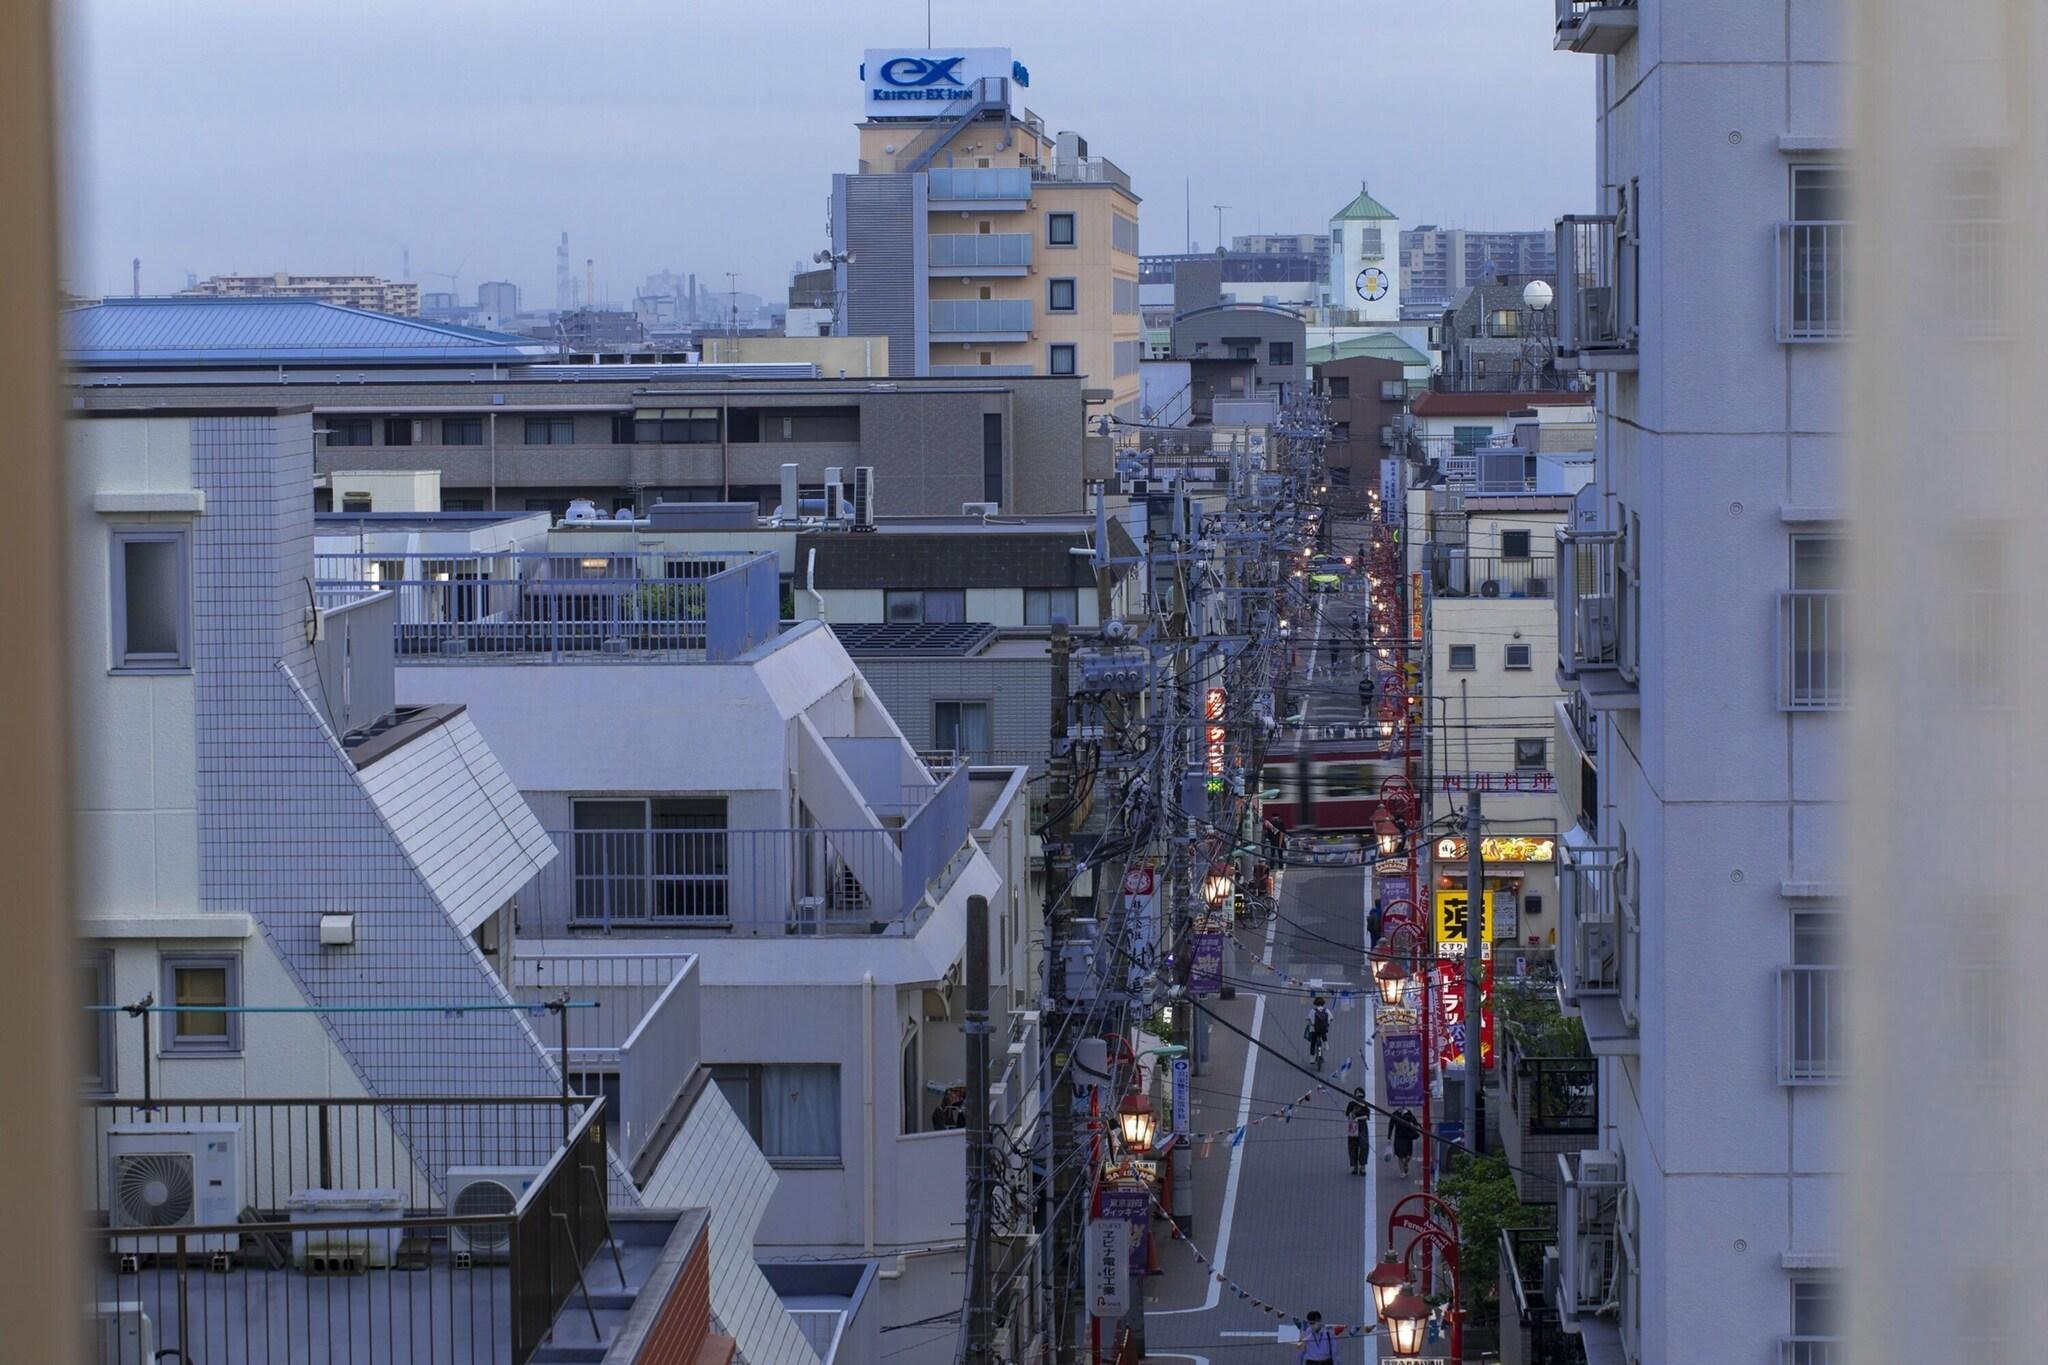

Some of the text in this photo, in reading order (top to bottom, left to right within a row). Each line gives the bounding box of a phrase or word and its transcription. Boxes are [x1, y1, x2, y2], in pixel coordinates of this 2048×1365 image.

[873, 89, 923, 100] KEIKYU
[926, 89, 945, 100] EX
[1442, 772, 1553, 791] 四川料理
[1444, 898, 1486, 939] 薬
